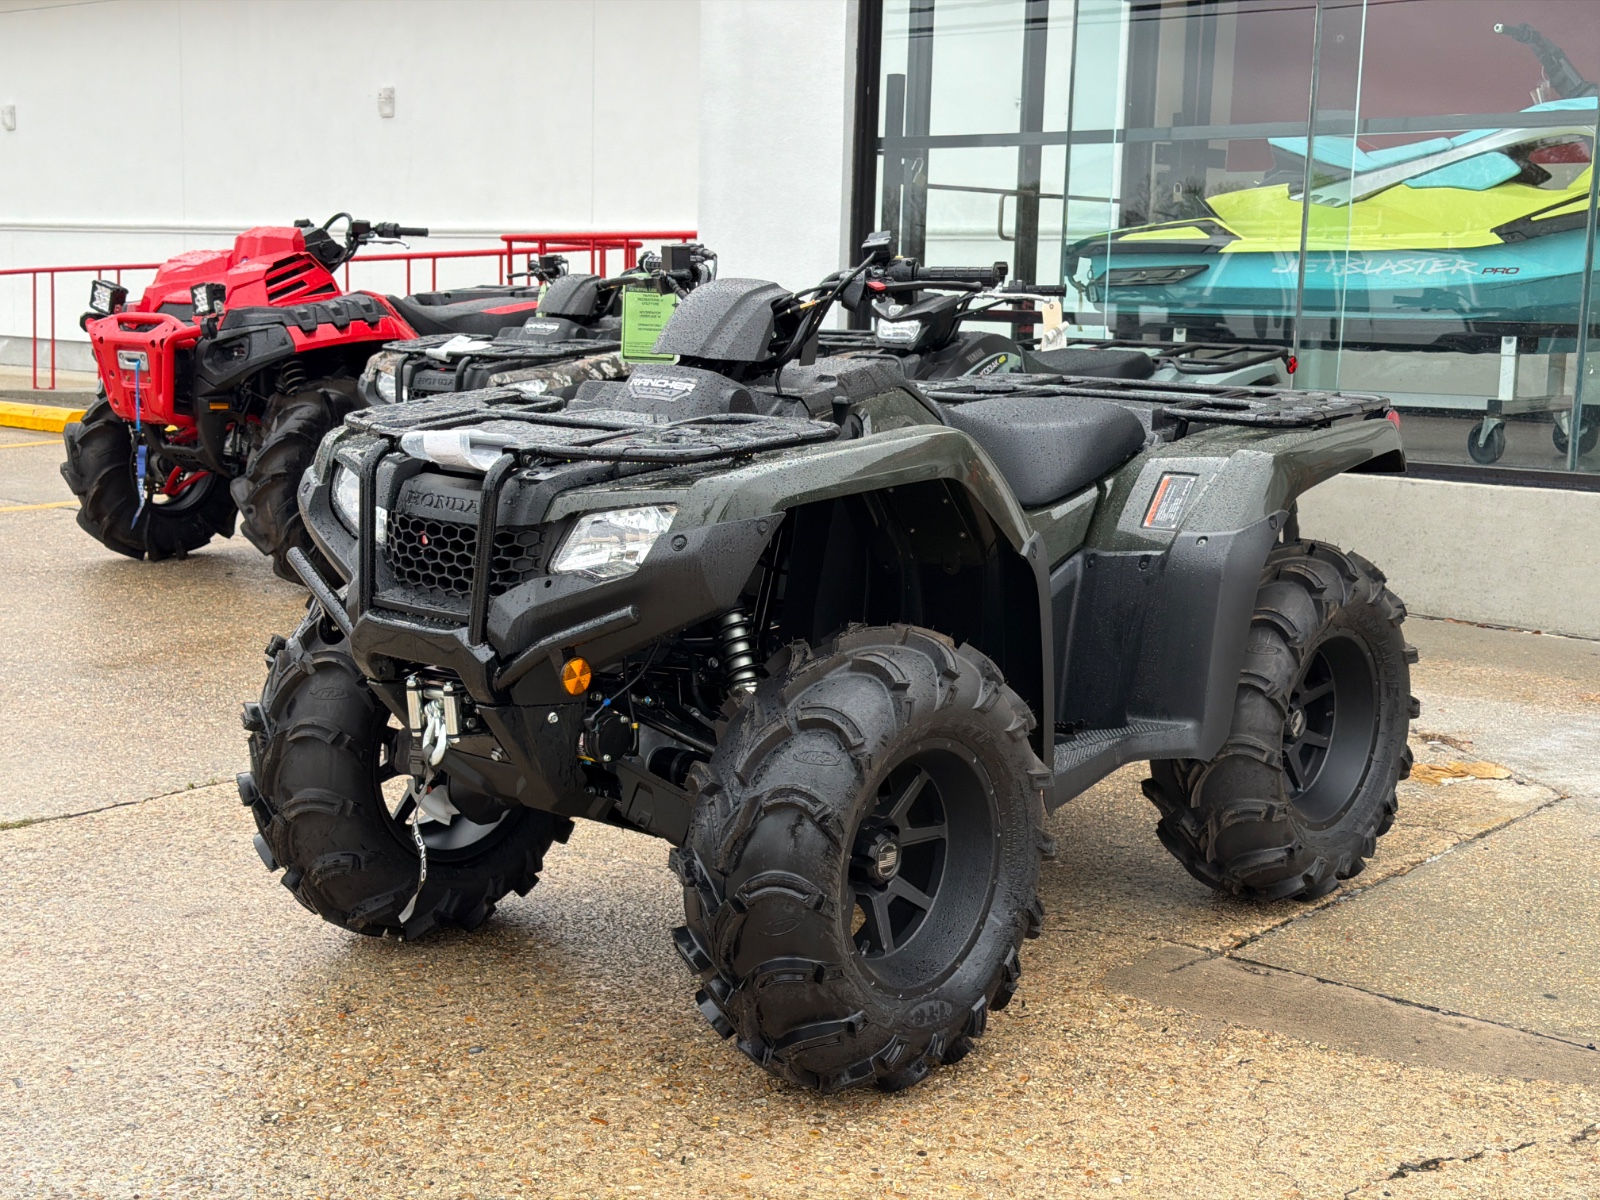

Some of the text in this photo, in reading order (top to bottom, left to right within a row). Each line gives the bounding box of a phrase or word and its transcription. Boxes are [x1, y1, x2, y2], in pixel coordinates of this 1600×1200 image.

[1481, 267, 1520, 275] PRO
[417, 377, 455, 387] HONDA
[629, 378, 697, 392] RANCHER
[406, 489, 480, 514] HONDA
